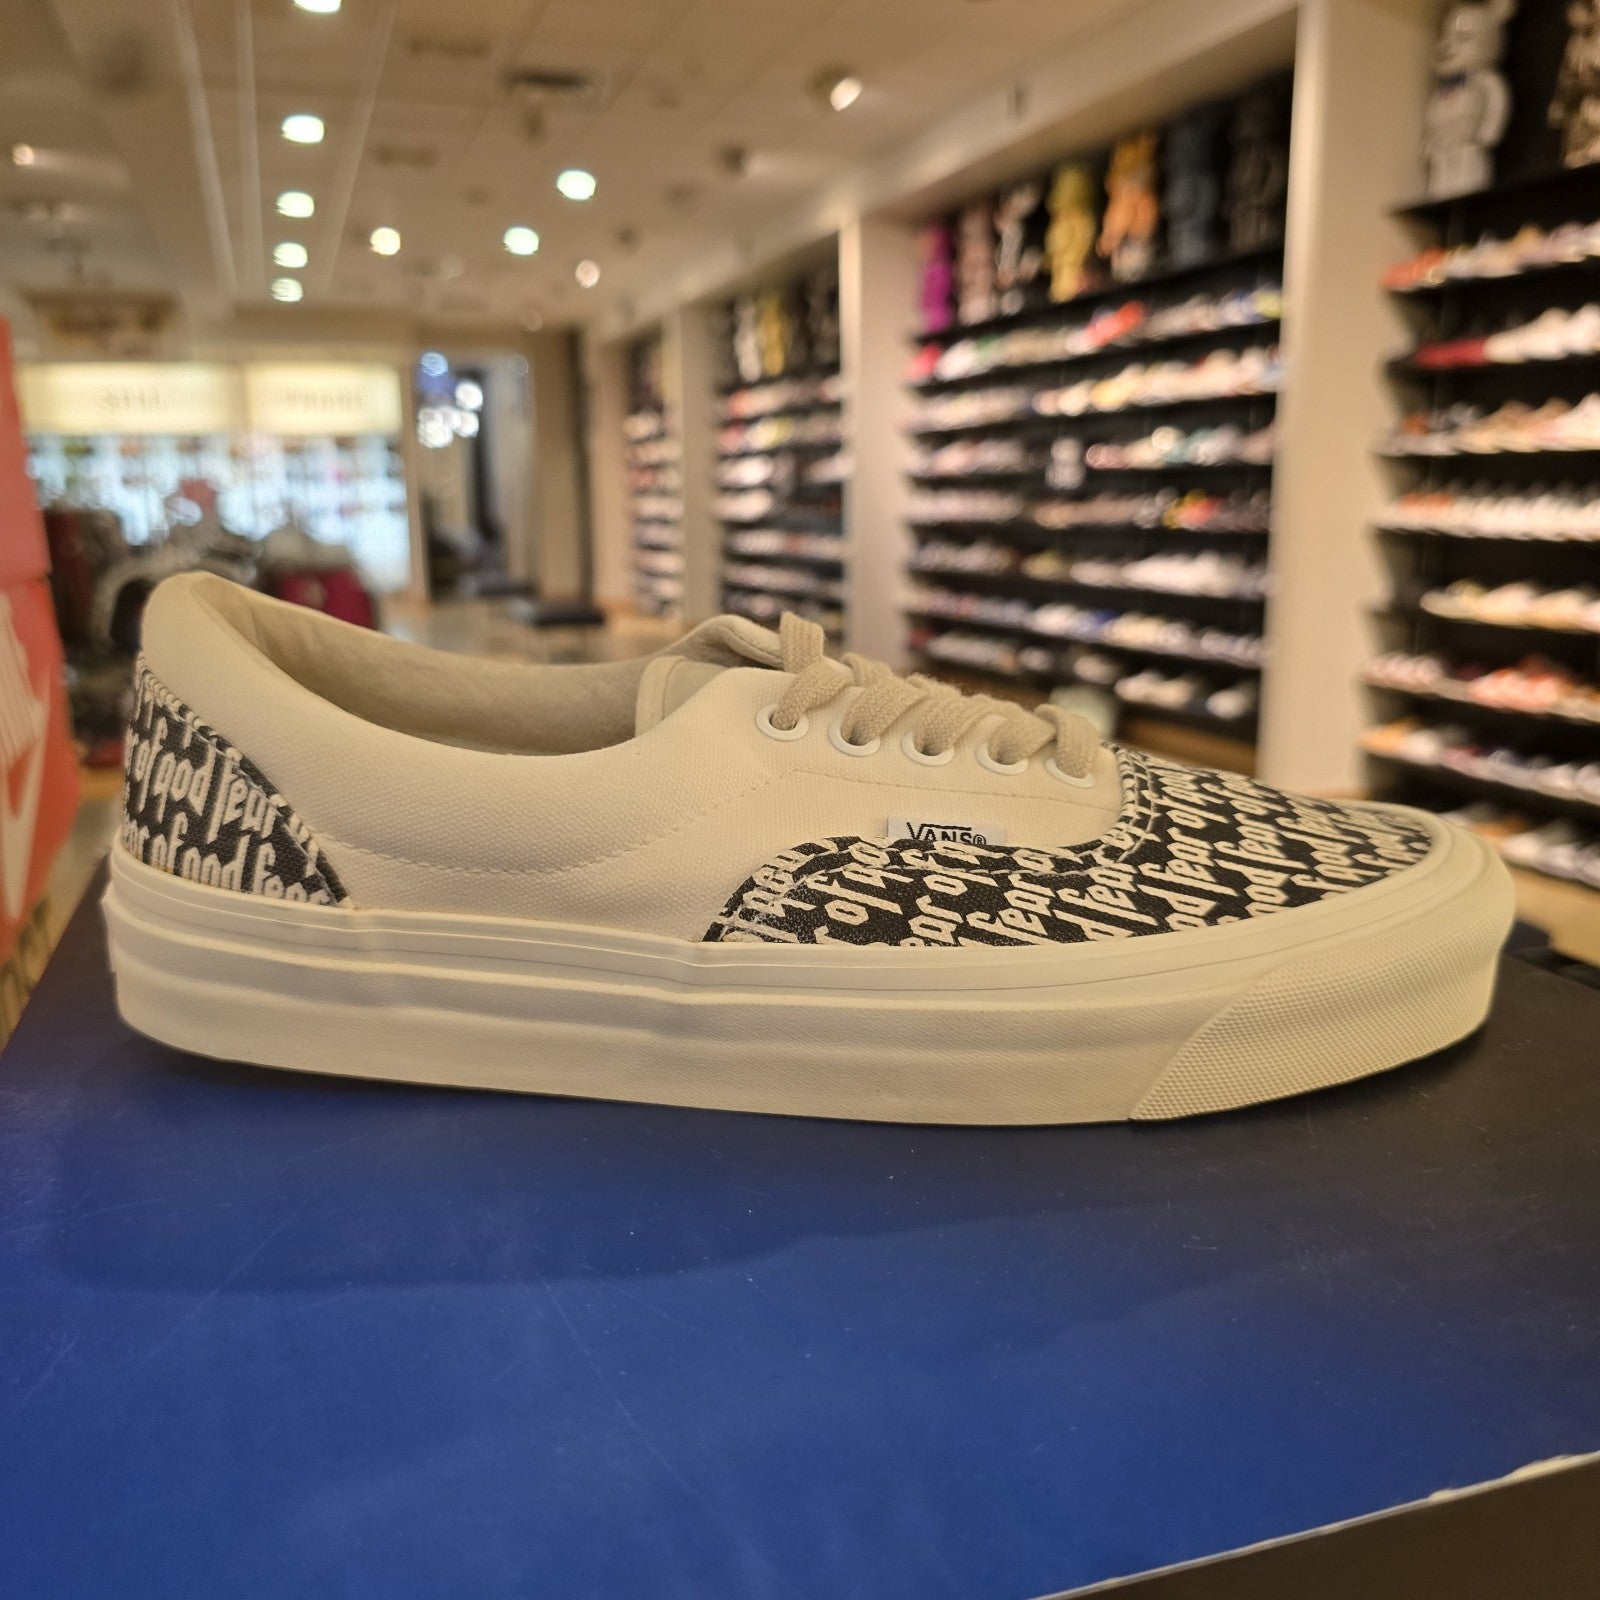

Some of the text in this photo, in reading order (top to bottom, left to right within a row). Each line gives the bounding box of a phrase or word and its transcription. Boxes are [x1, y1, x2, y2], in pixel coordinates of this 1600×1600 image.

[152, 738, 217, 824] god
[1140, 789, 1230, 830] of
[1138, 827, 1239, 897] fear
[1213, 812, 1309, 870] fear
[806, 868, 903, 926] of
[965, 873, 1065, 945] fear
[1056, 848, 1158, 926] fear
